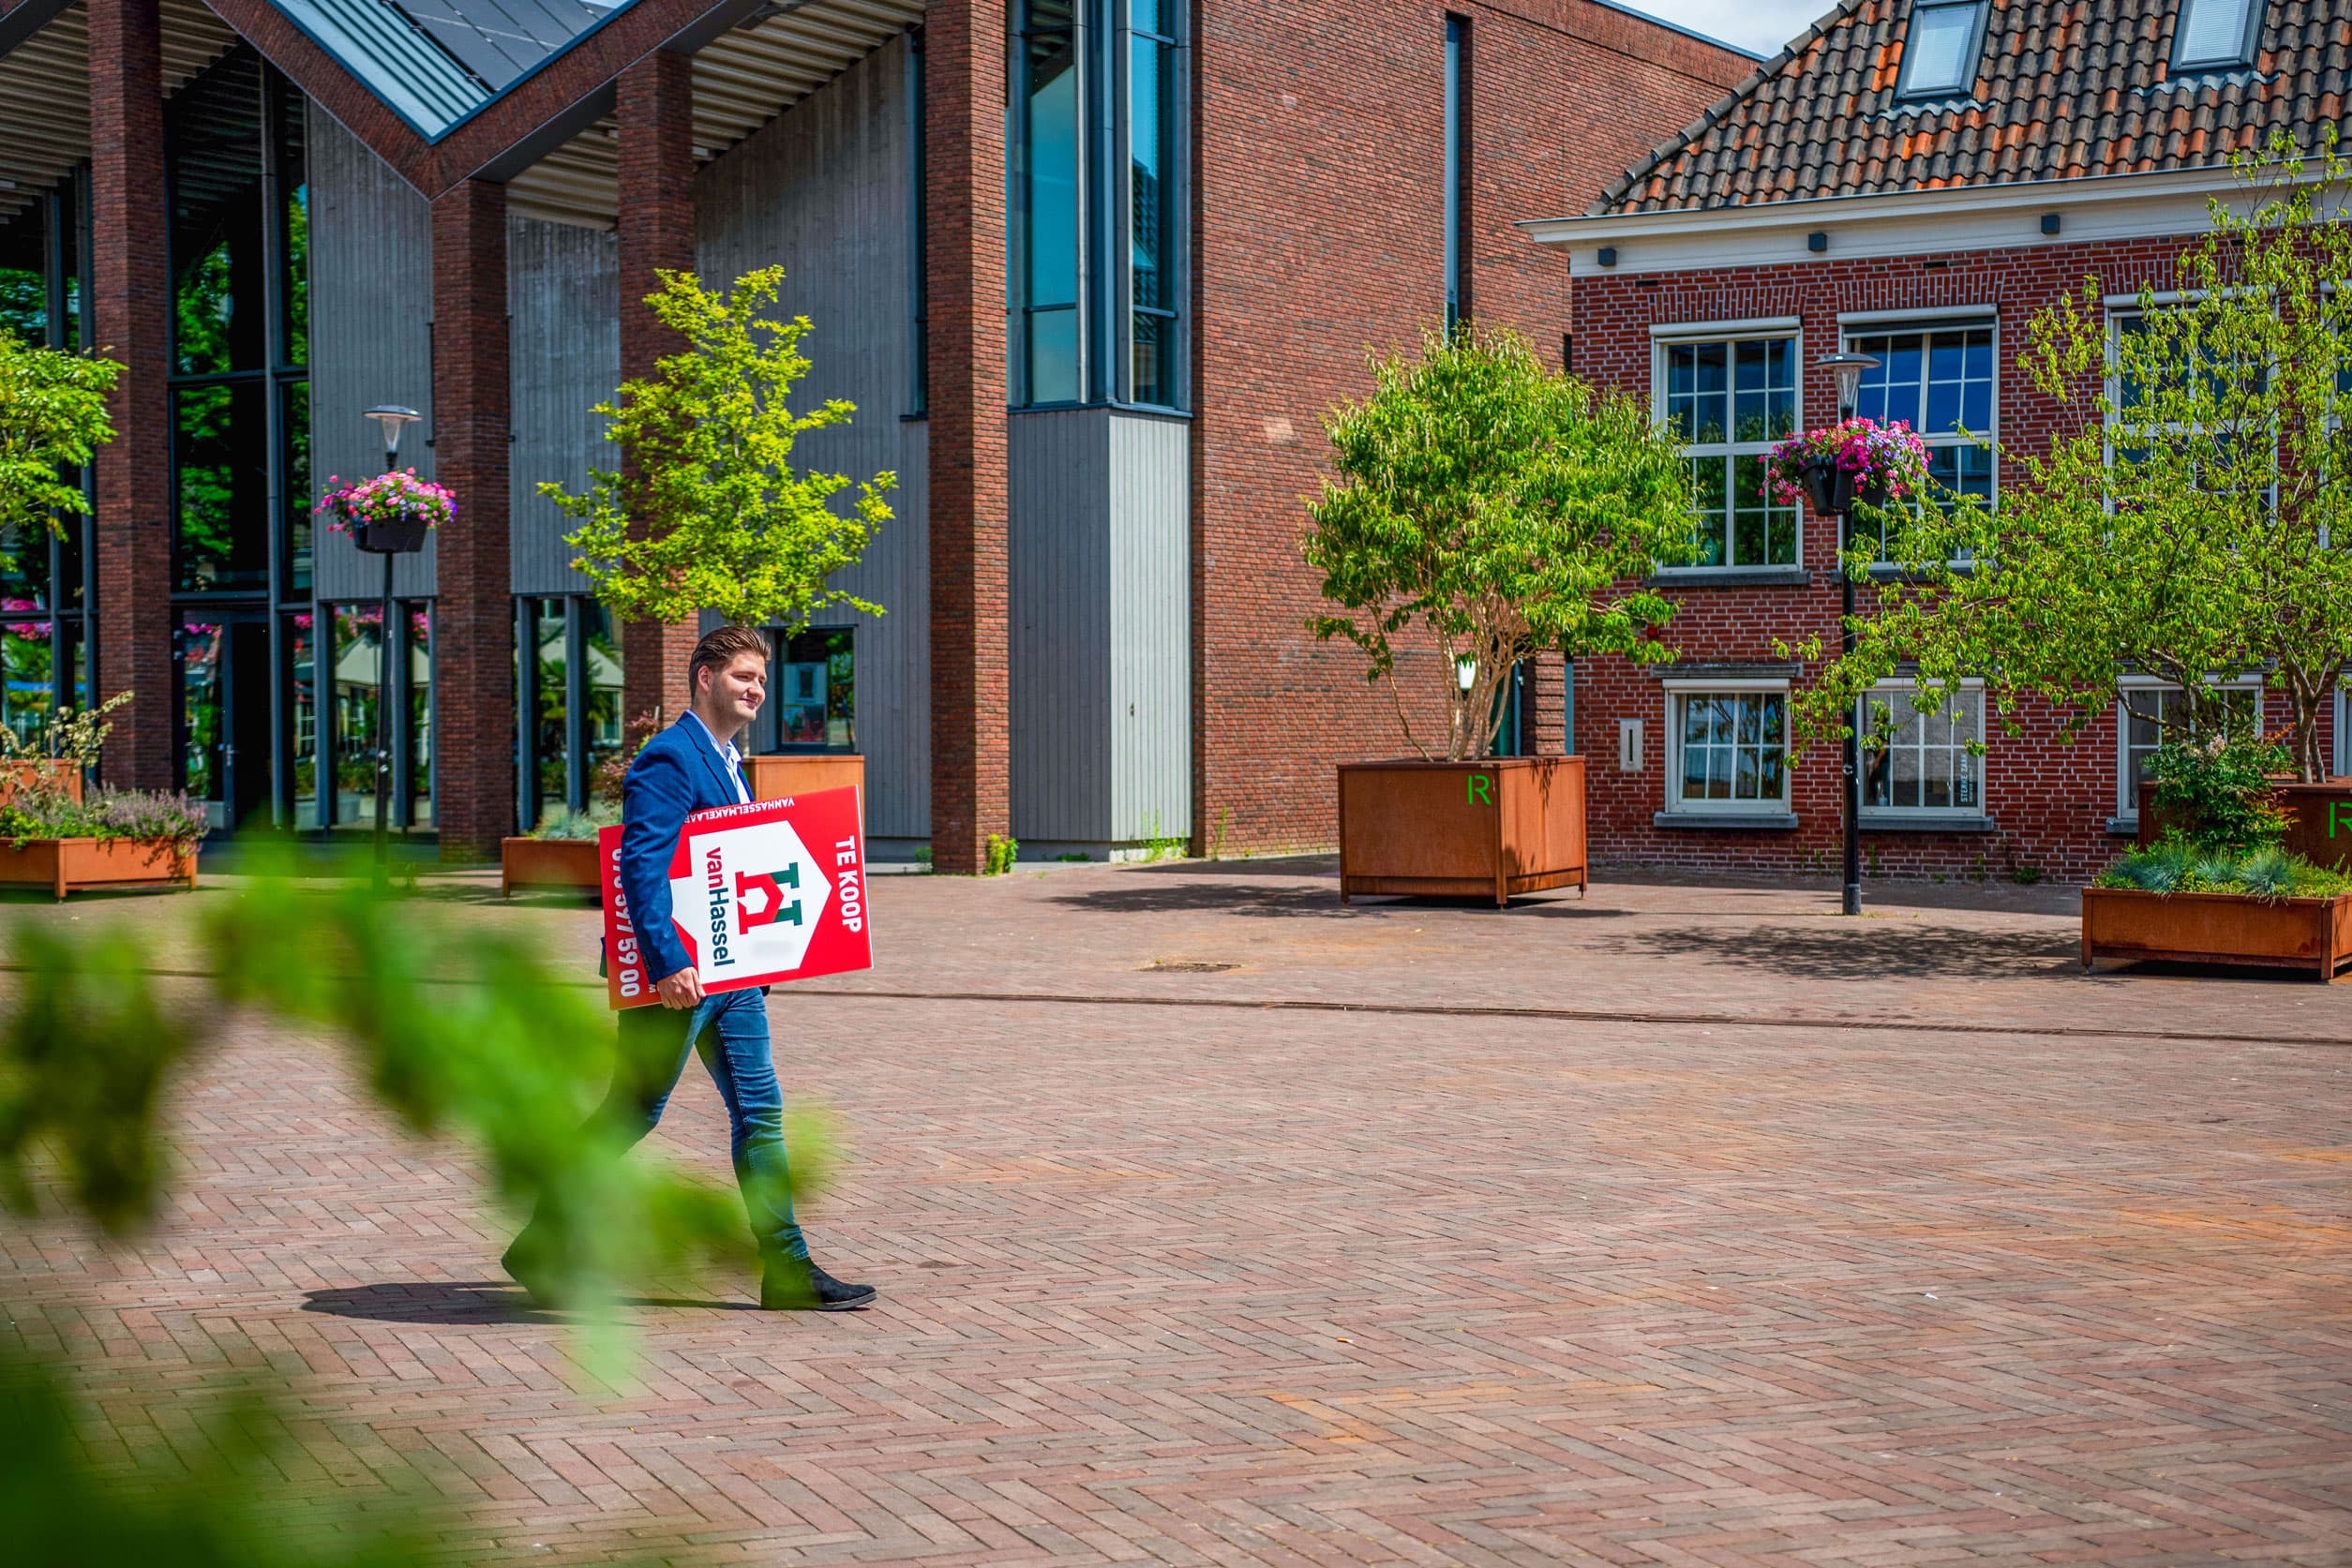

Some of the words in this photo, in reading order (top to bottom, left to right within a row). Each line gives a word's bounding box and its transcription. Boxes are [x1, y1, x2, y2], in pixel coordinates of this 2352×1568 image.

[835, 836, 858, 866] TE
[706, 846, 736, 967] vanHassel
[837, 869, 862, 933] KOOP
[616, 937, 638, 964] 59
[619, 968, 640, 997] 00
